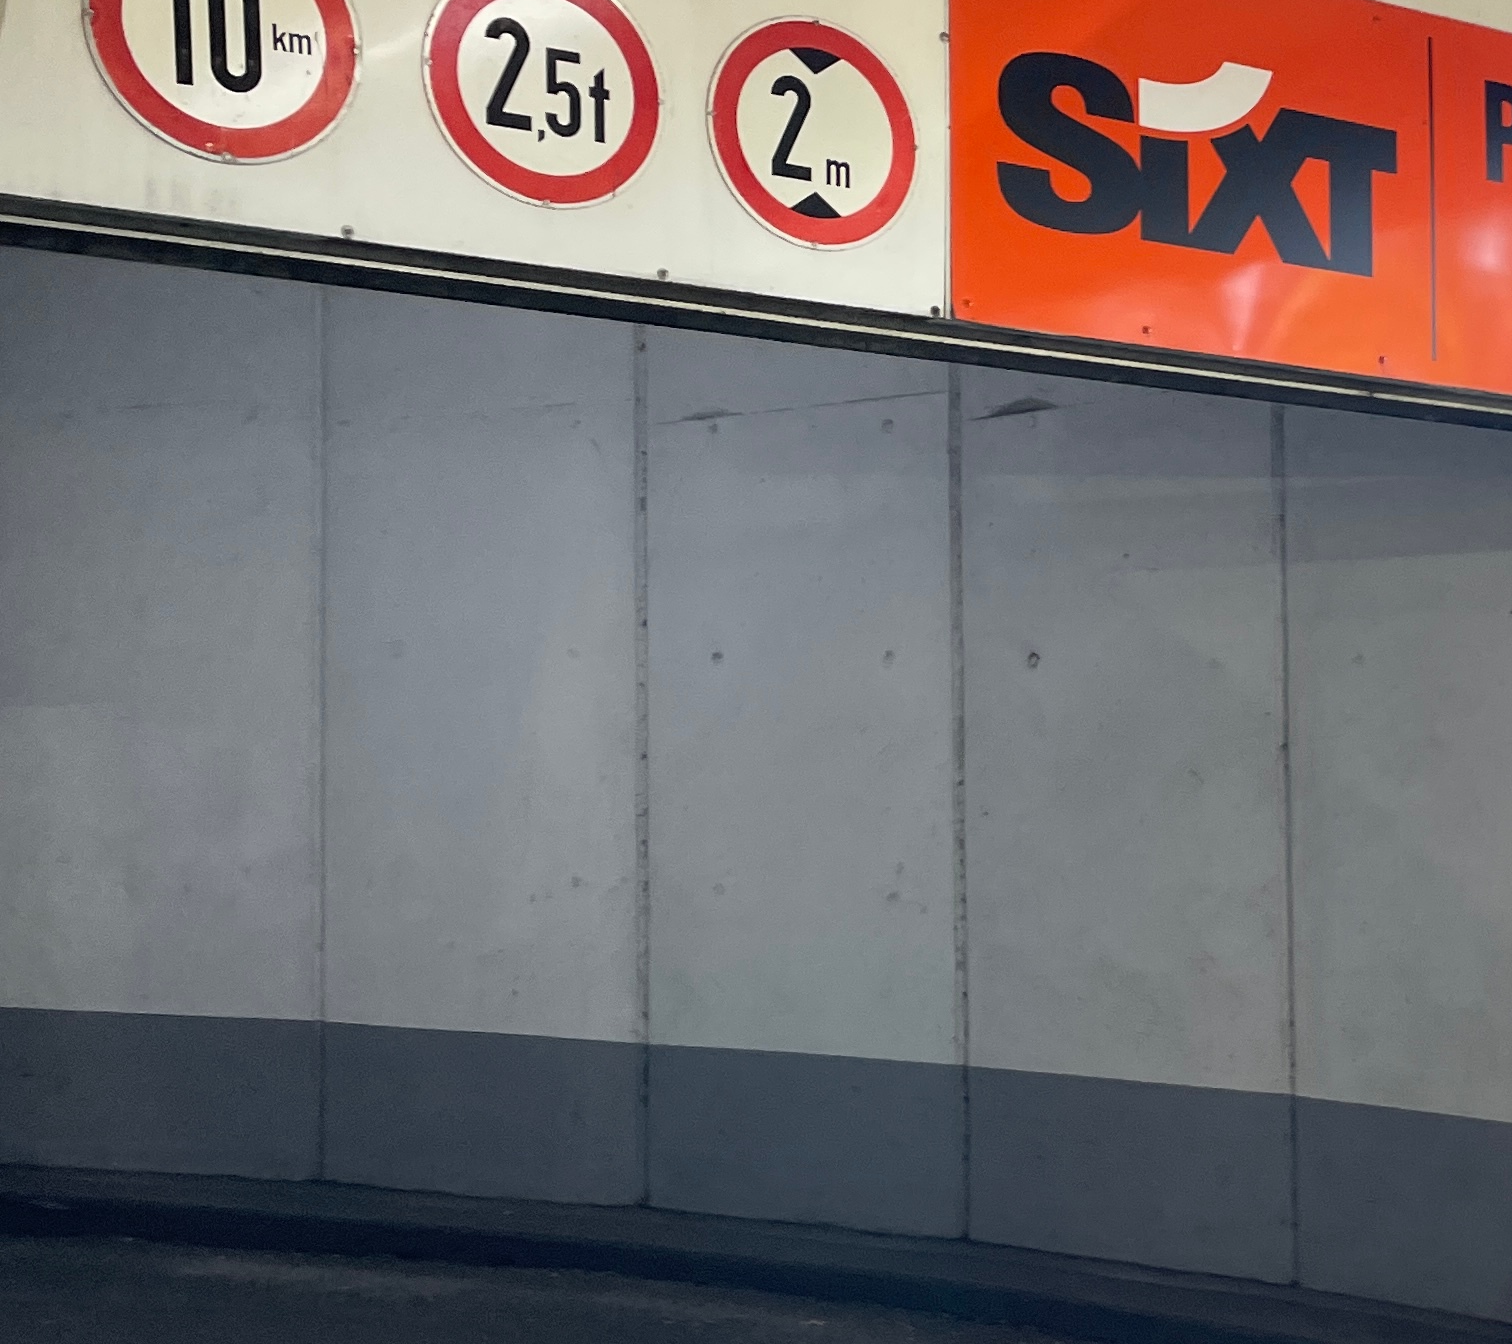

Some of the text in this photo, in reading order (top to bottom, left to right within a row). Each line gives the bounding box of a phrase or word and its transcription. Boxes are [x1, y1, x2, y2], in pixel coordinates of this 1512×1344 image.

[271, 22, 313, 56] km
[770, 74, 851, 189] 2 m
